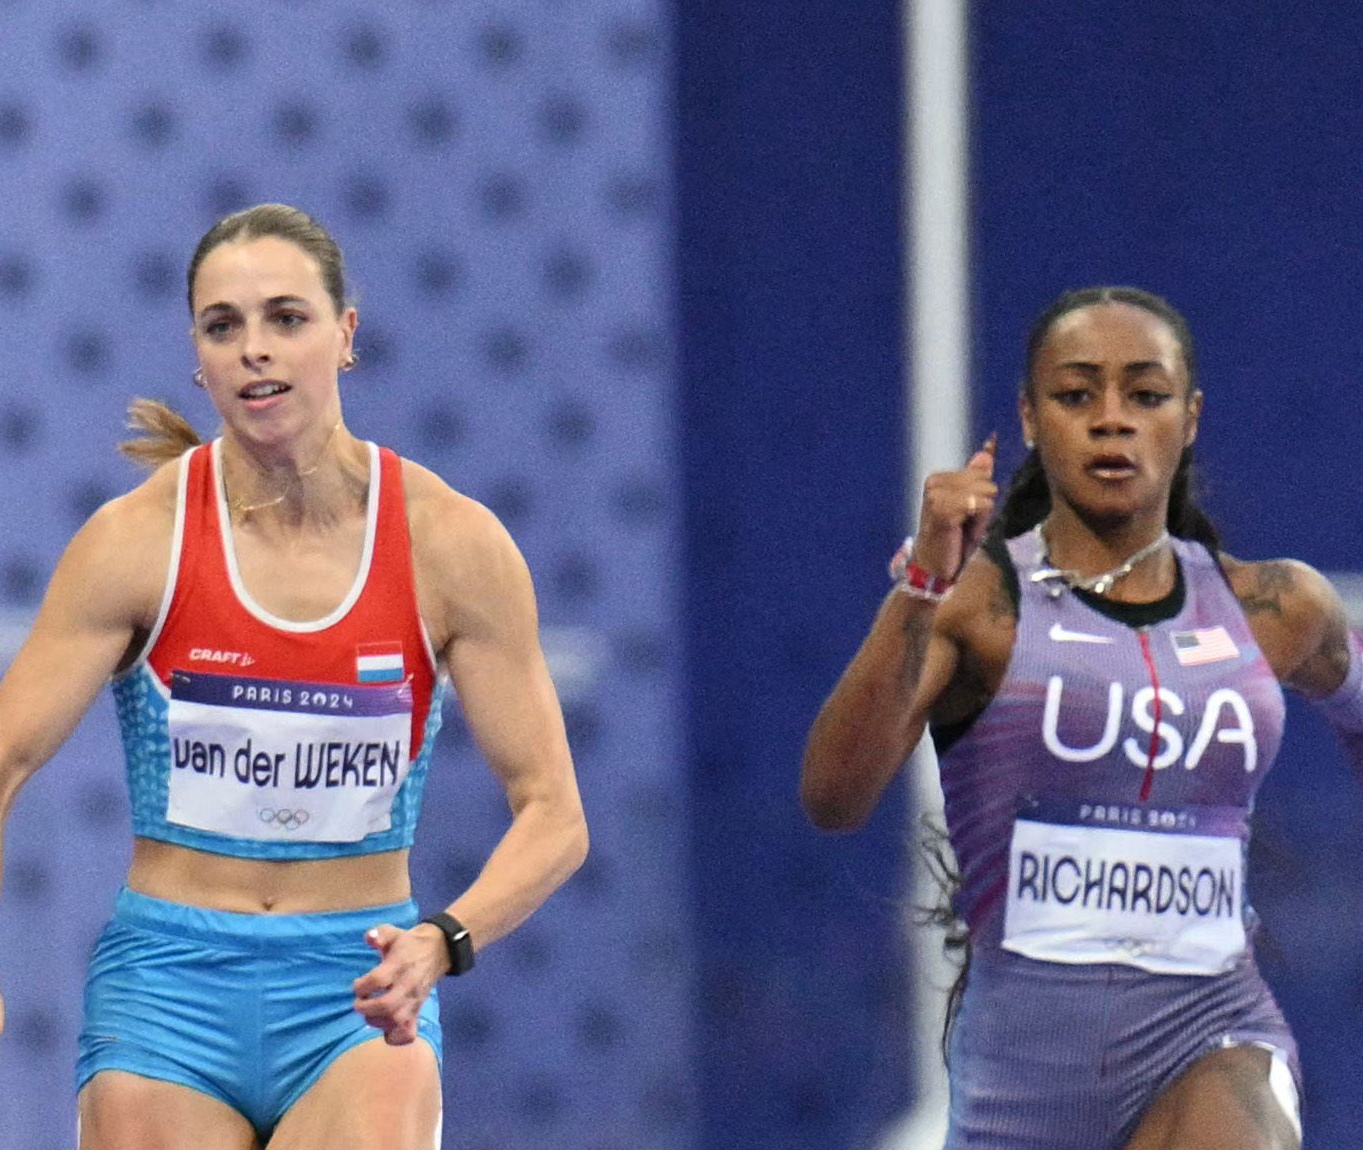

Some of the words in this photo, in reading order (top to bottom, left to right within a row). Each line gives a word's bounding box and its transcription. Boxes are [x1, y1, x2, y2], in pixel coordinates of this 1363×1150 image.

[188, 647, 242, 665] CRAFT
[232, 685, 293, 704] PARIS
[299, 692, 354, 709] 2024
[1041, 675, 1258, 773] USA
[174, 738, 226, 778] van
[234, 738, 286, 789] der
[293, 740, 401, 790] WEKEN
[1079, 804, 1143, 826] PARIS
[1018, 851, 1235, 919] RICHARDSON
